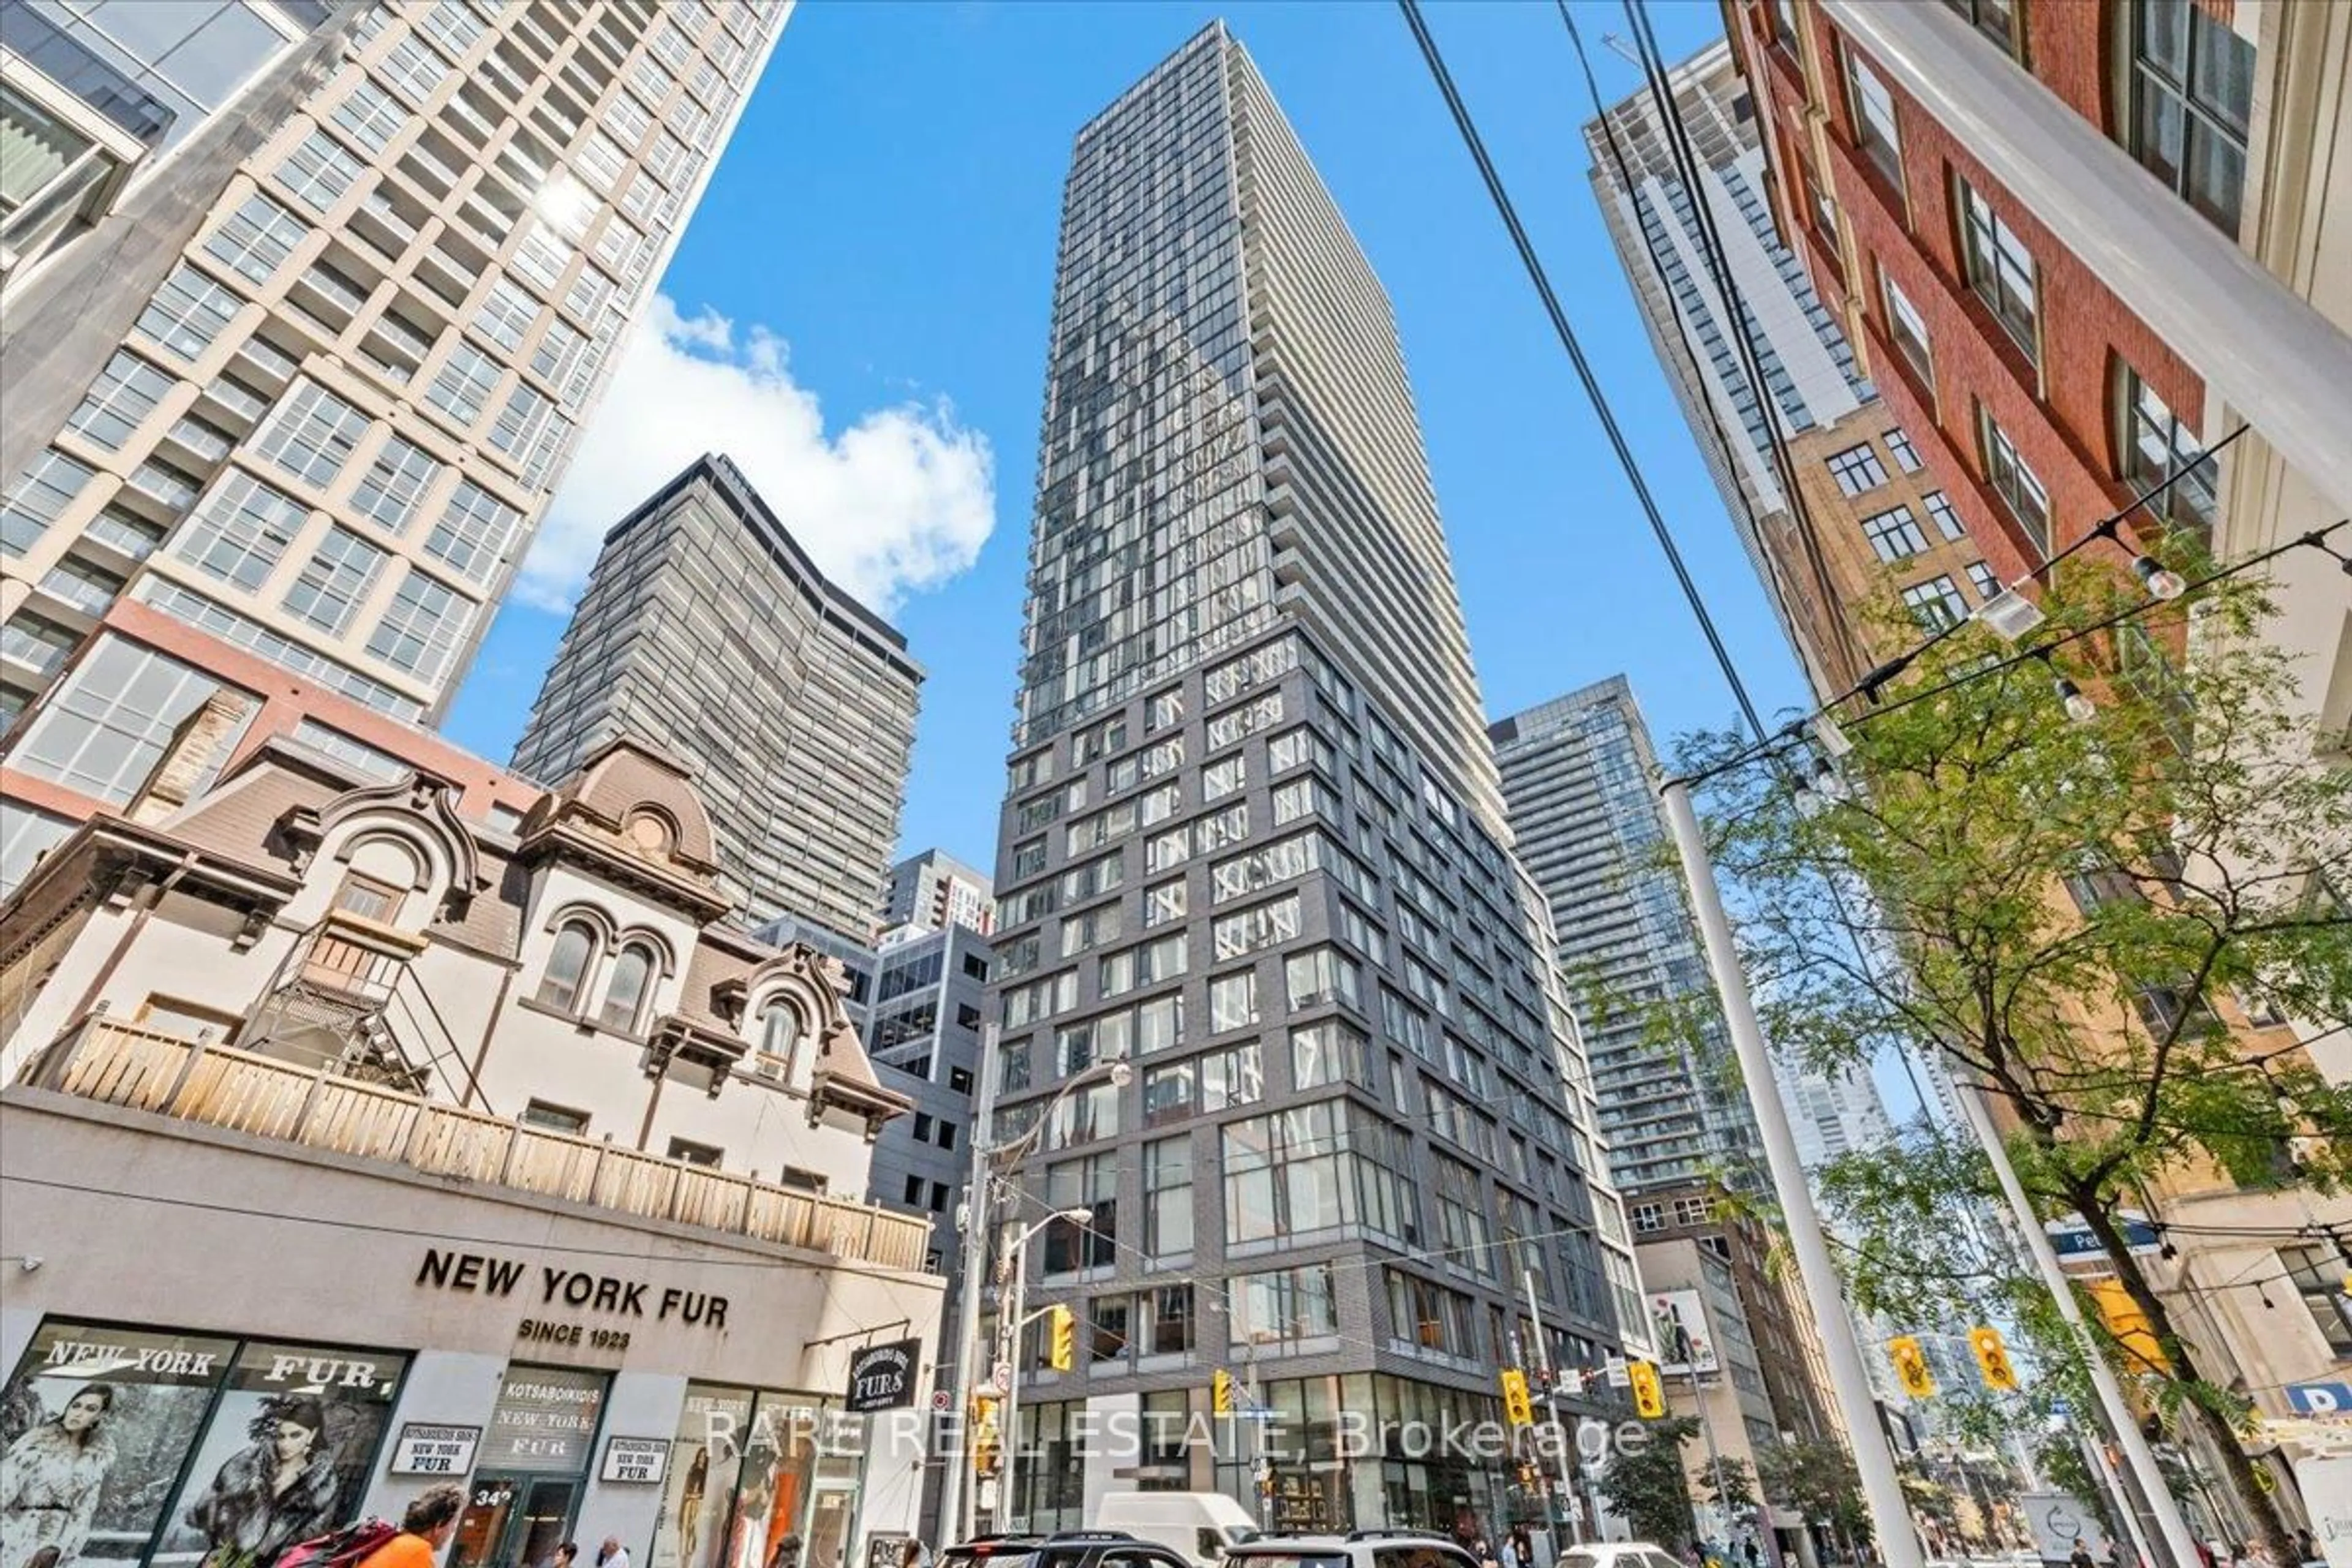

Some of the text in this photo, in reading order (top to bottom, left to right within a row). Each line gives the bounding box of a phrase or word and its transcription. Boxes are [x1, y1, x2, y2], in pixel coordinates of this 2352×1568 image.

[415, 1248, 729, 1328] NEW YORK FUR
[518, 1319, 584, 1346] SINCE
[44, 1340, 216, 1376] NEW YORK
[263, 1354, 377, 1388] FUR
[856, 1371, 903, 1399] FURS
[497, 1409, 540, 1426] NEW
[511, 1438, 567, 1456] FUR
[411, 1456, 451, 1471] FUR
[617, 1466, 648, 1479] FUR
